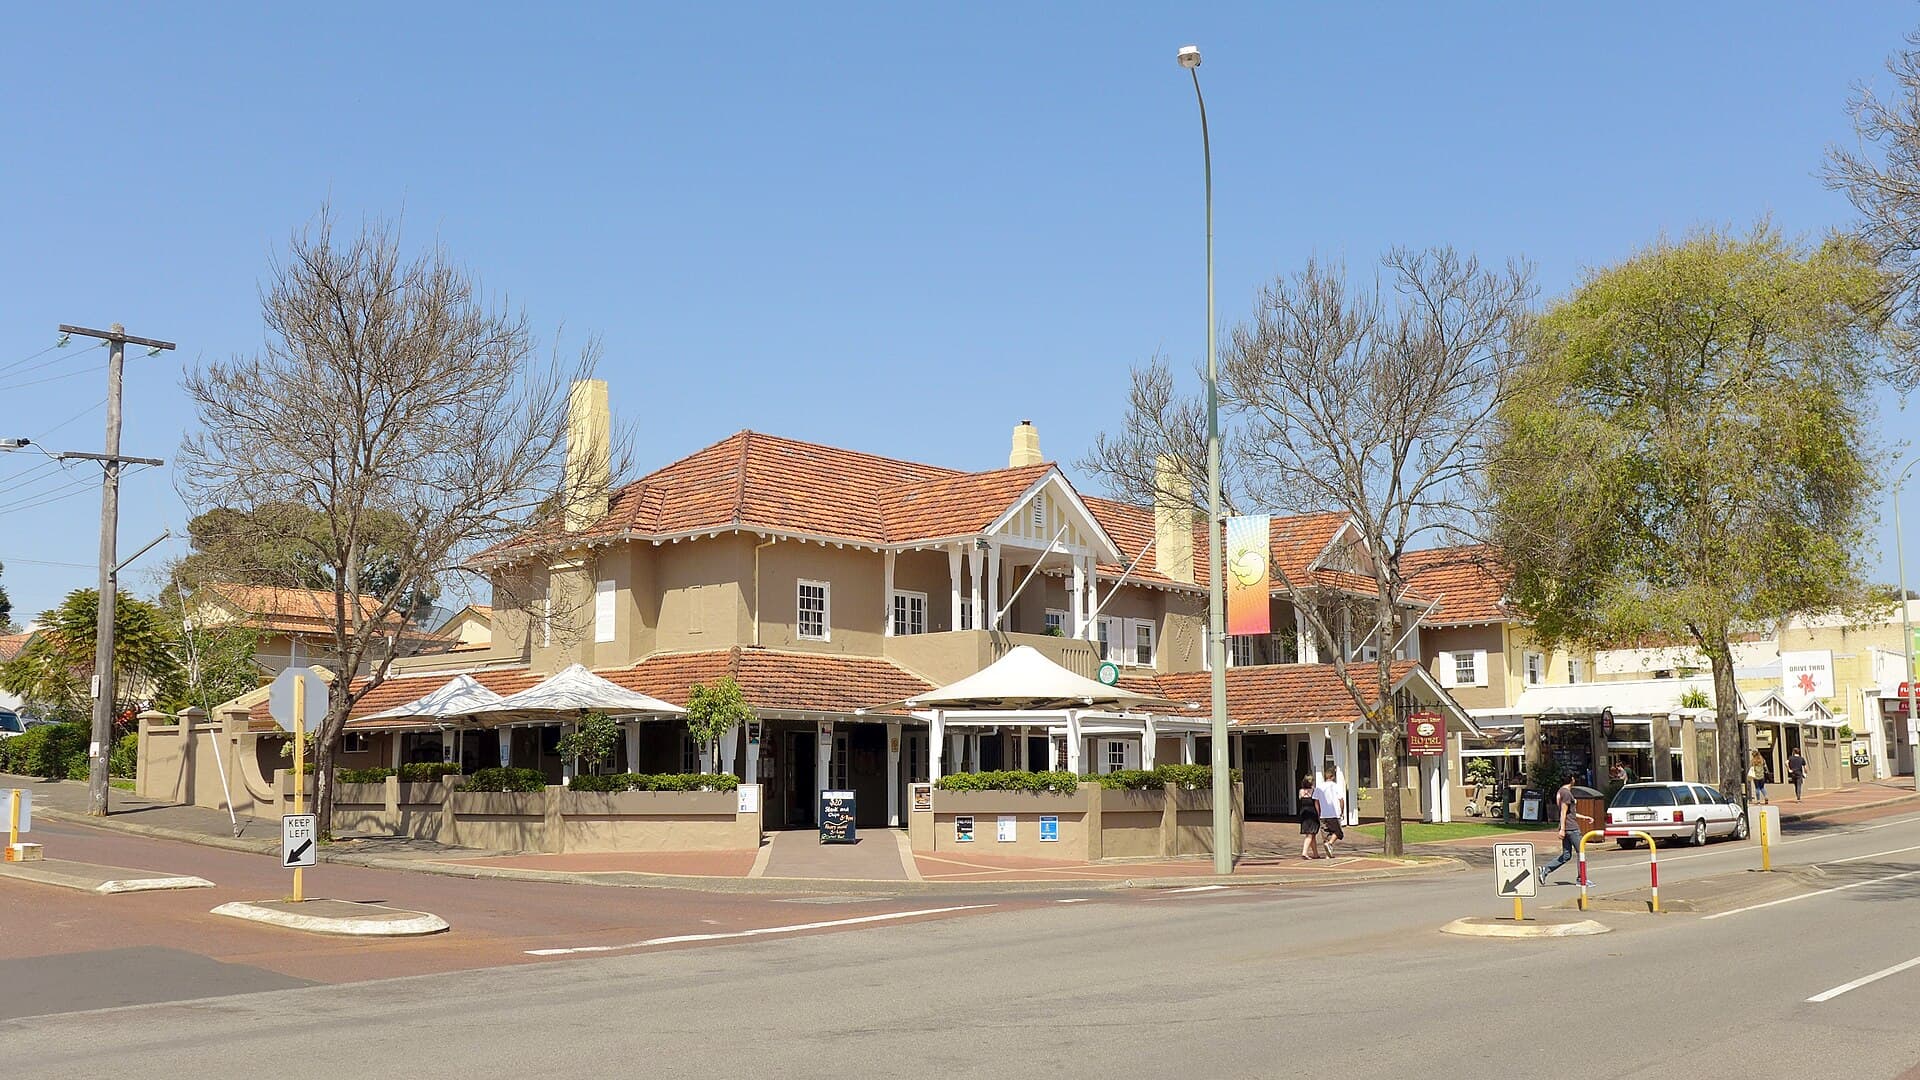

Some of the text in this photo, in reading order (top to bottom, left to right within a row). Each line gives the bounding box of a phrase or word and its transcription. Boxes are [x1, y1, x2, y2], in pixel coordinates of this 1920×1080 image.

[1411, 736, 1441, 744] HOTEL
[288, 819, 310, 827] KEEP
[289, 830, 310, 838] LEFT
[1501, 848, 1526, 856] KEEP
[1503, 859, 1526, 867] LEFT
